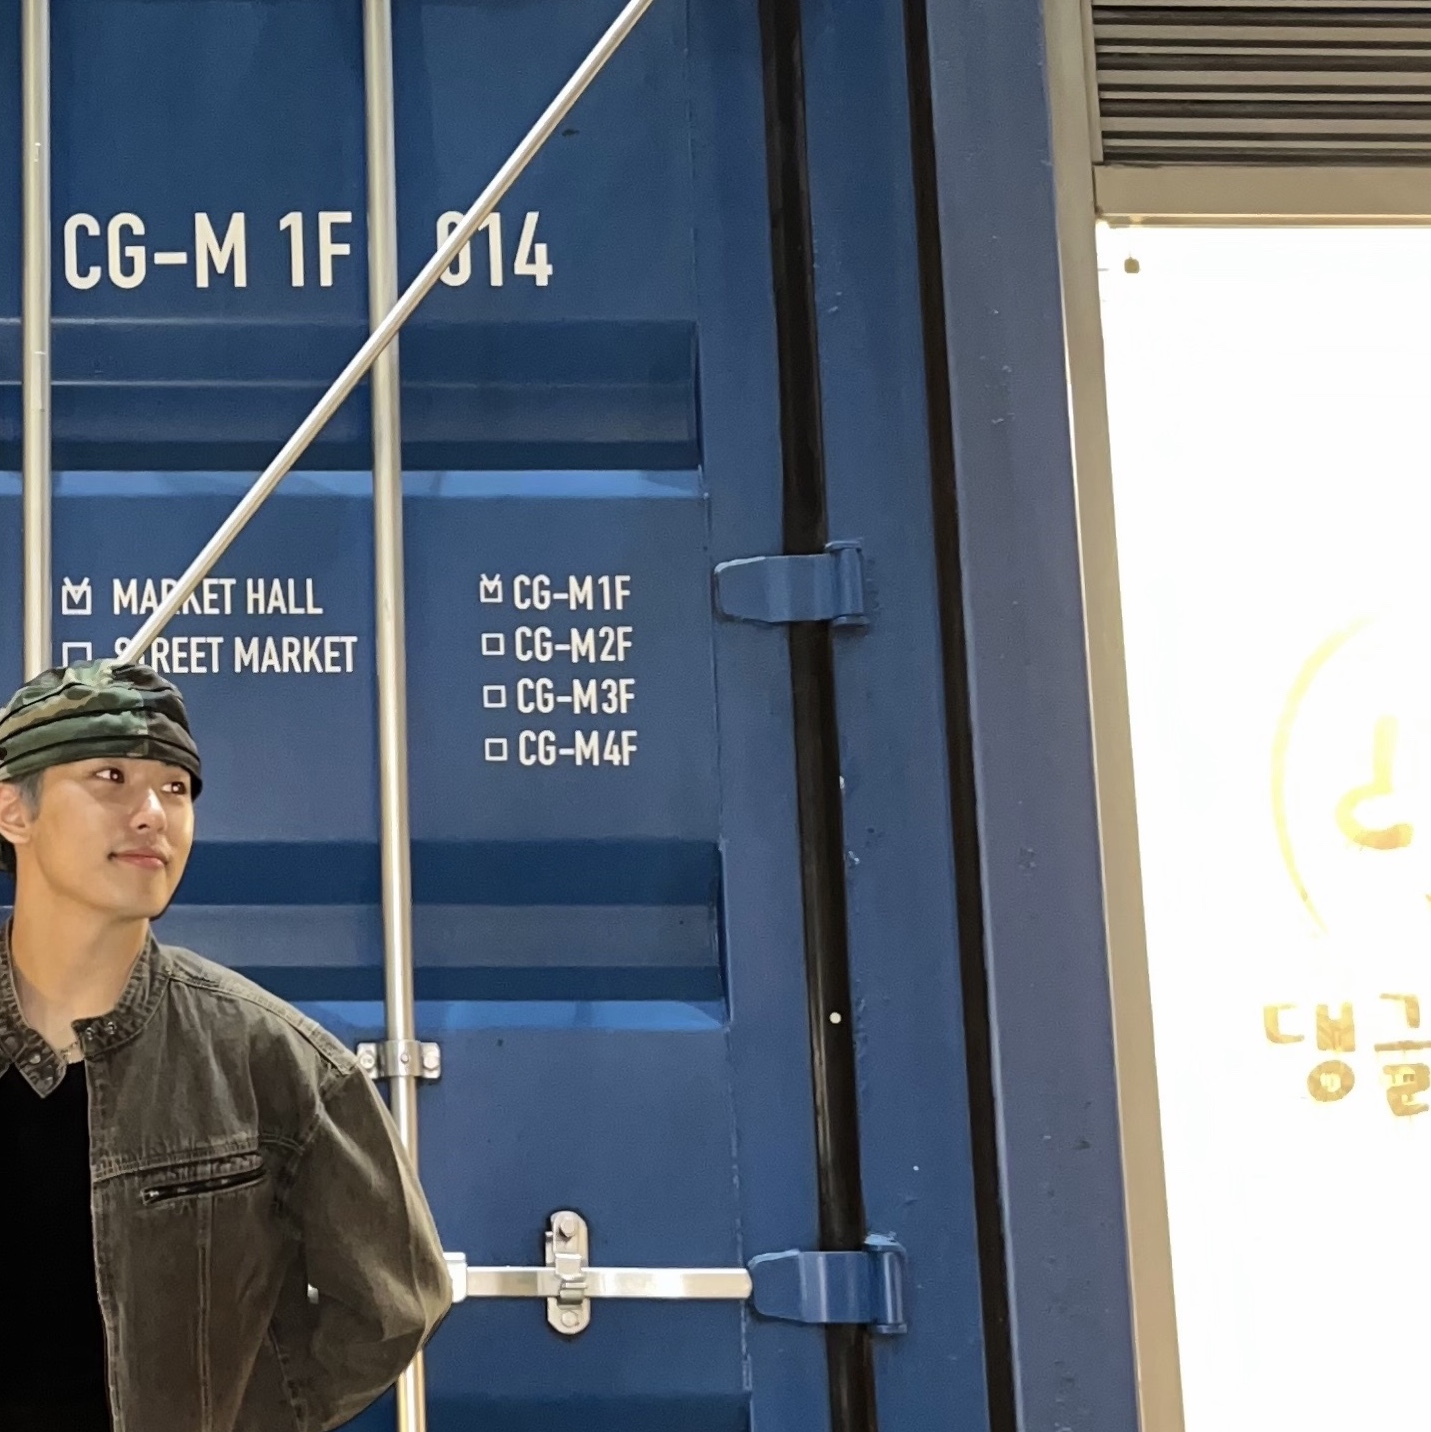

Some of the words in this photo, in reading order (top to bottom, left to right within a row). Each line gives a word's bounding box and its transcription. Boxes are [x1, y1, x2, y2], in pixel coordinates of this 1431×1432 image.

[64, 212, 247, 290] CG-M
[279, 211, 353, 287] 1F
[247, 578, 324, 615] HALL
[513, 574, 631, 610] CG-M1F
[114, 636, 224, 674] REET
[234, 636, 358, 674] MARKET
[515, 626, 633, 663] CG-M2F
[517, 678, 635, 714] CG-M3F
[519, 730, 638, 766] CG-M4F
